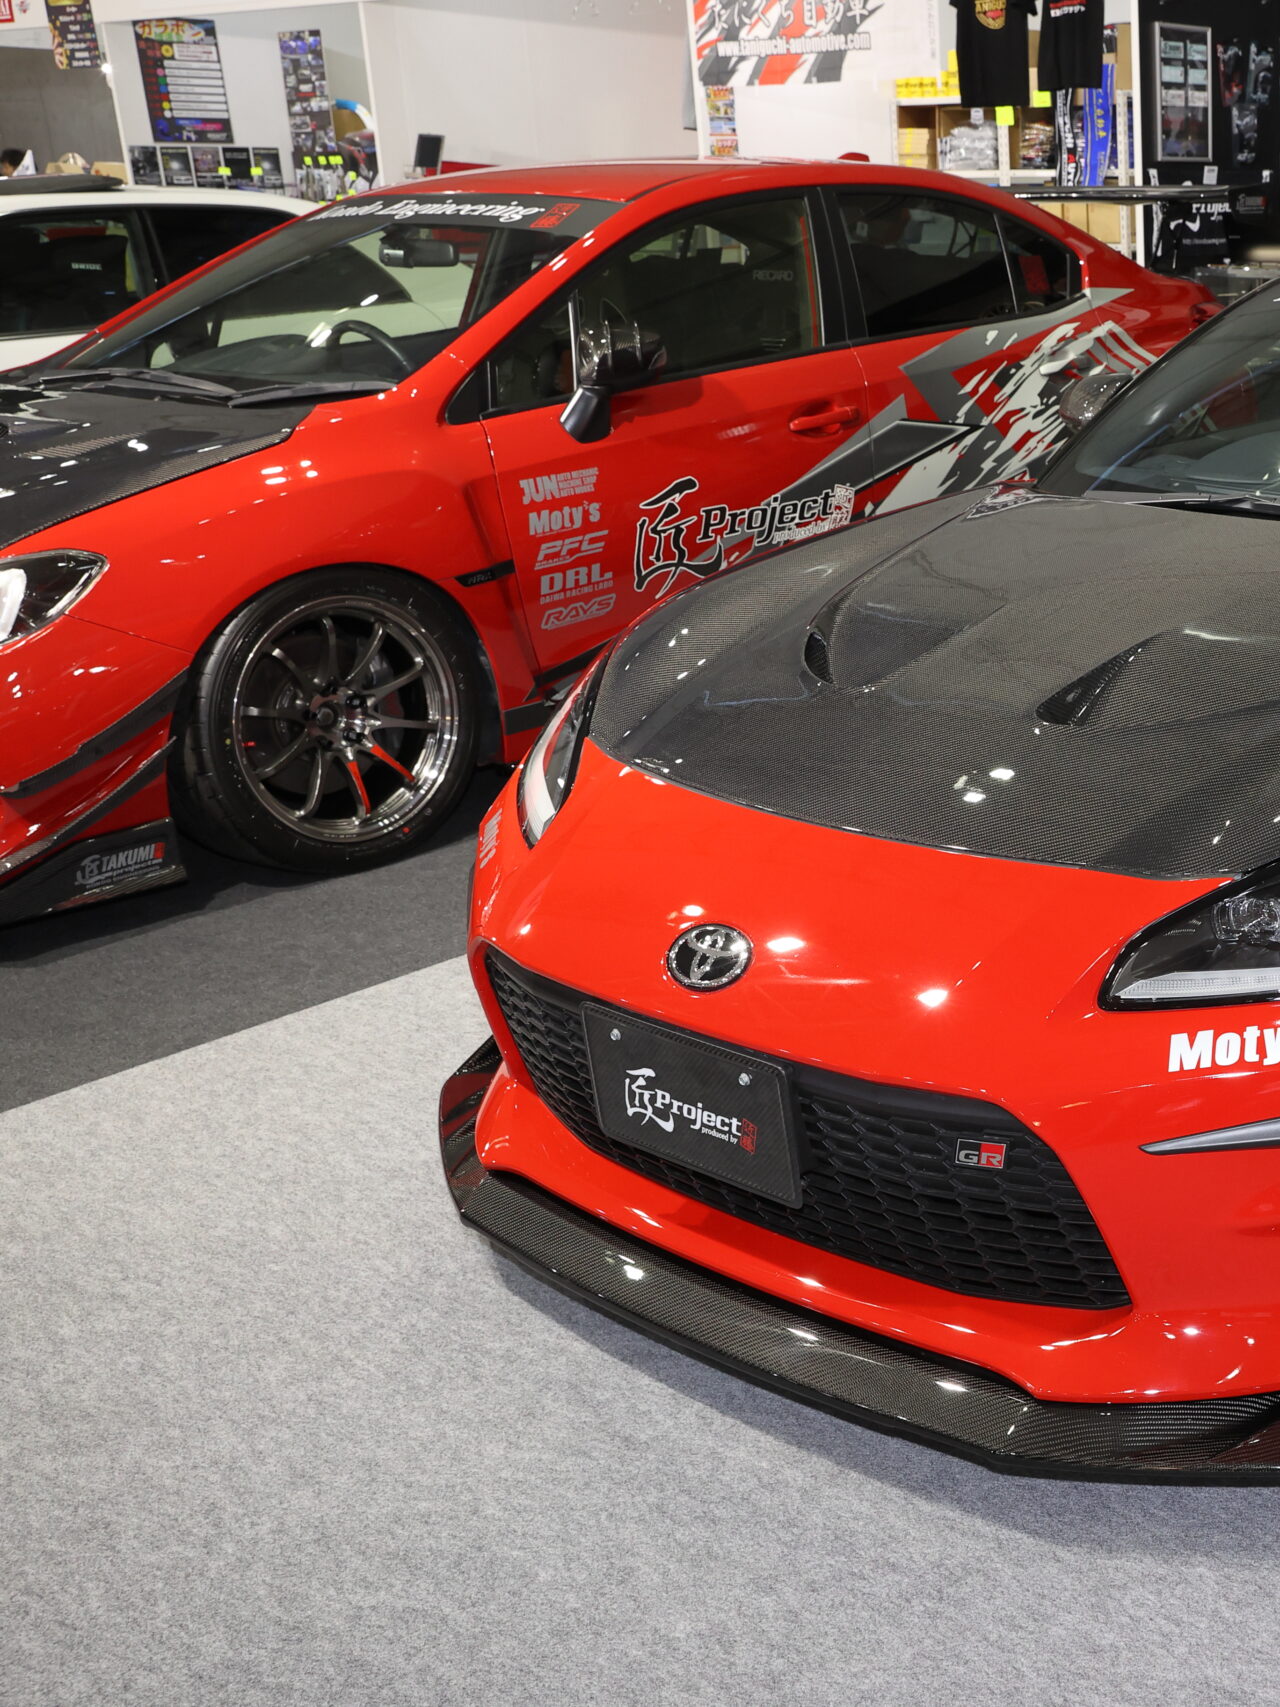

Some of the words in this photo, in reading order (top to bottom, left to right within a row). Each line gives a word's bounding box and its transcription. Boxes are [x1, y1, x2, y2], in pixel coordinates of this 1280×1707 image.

[374, 199, 546, 223] Engineering
[519, 473, 560, 505] JUN
[528, 500, 602, 537] Moty's
[696, 488, 837, 547] Project
[537, 529, 609, 562] PFC
[540, 562, 613, 595] DRL
[541, 592, 617, 630] RAYS
[101, 843, 156, 872] TAKUMI
[625, 1067, 675, 1133] 匠
[654, 1088, 742, 1137] Project
[701, 1126, 729, 1143] produced
[729, 1135, 738, 1145] by
[958, 1149, 1002, 1167] GR
